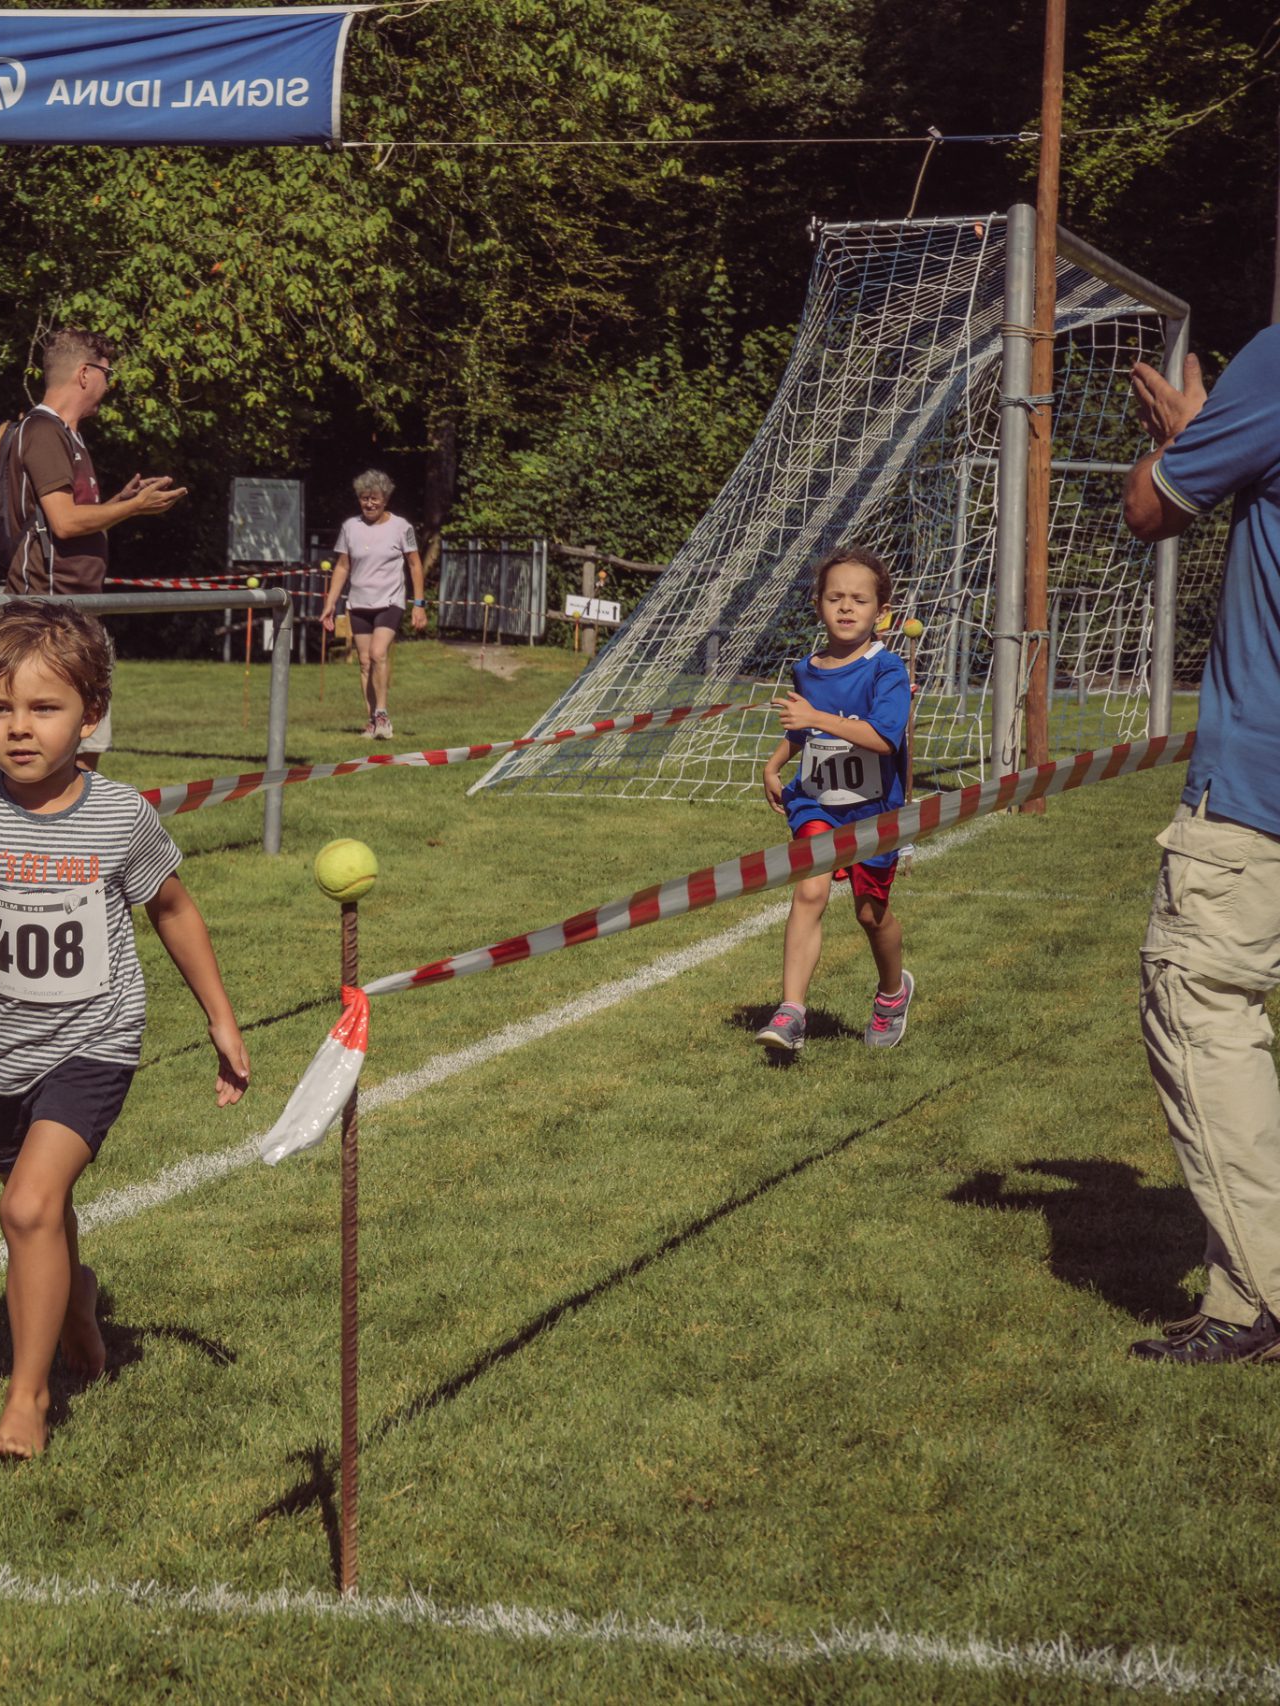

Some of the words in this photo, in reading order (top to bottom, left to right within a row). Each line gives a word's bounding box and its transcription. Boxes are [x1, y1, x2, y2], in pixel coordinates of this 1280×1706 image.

[810, 755, 864, 791] 410
[20, 851, 51, 884] GET
[55, 855, 100, 885] WILD
